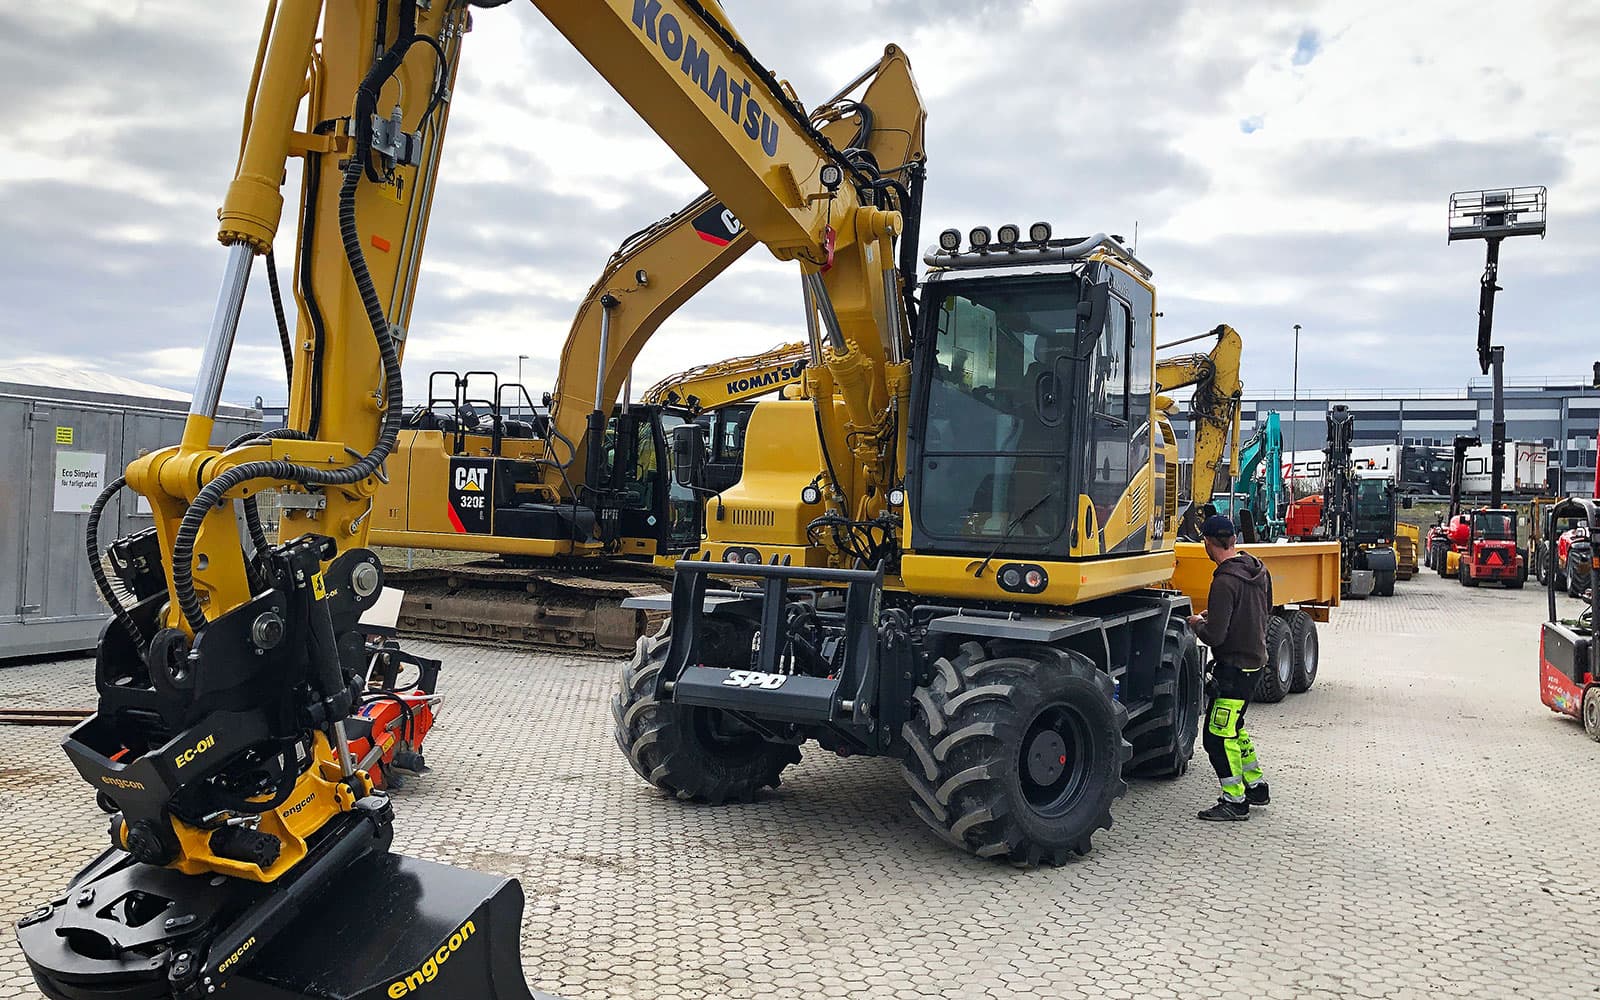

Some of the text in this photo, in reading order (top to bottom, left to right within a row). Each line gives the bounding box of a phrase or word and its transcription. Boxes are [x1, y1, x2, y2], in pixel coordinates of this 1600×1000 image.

[631, 0, 779, 157] KOMATSU
[727, 364, 802, 395] KOMATSU
[62, 469, 98, 479] Eco Simplex
[455, 467, 488, 491] CAT
[460, 495, 485, 508] 320E
[174, 734, 215, 769] EC-Oil
[101, 775, 145, 790] engcon
[282, 792, 316, 818] engcon
[218, 936, 256, 973] engcon
[387, 920, 476, 999] engcon
